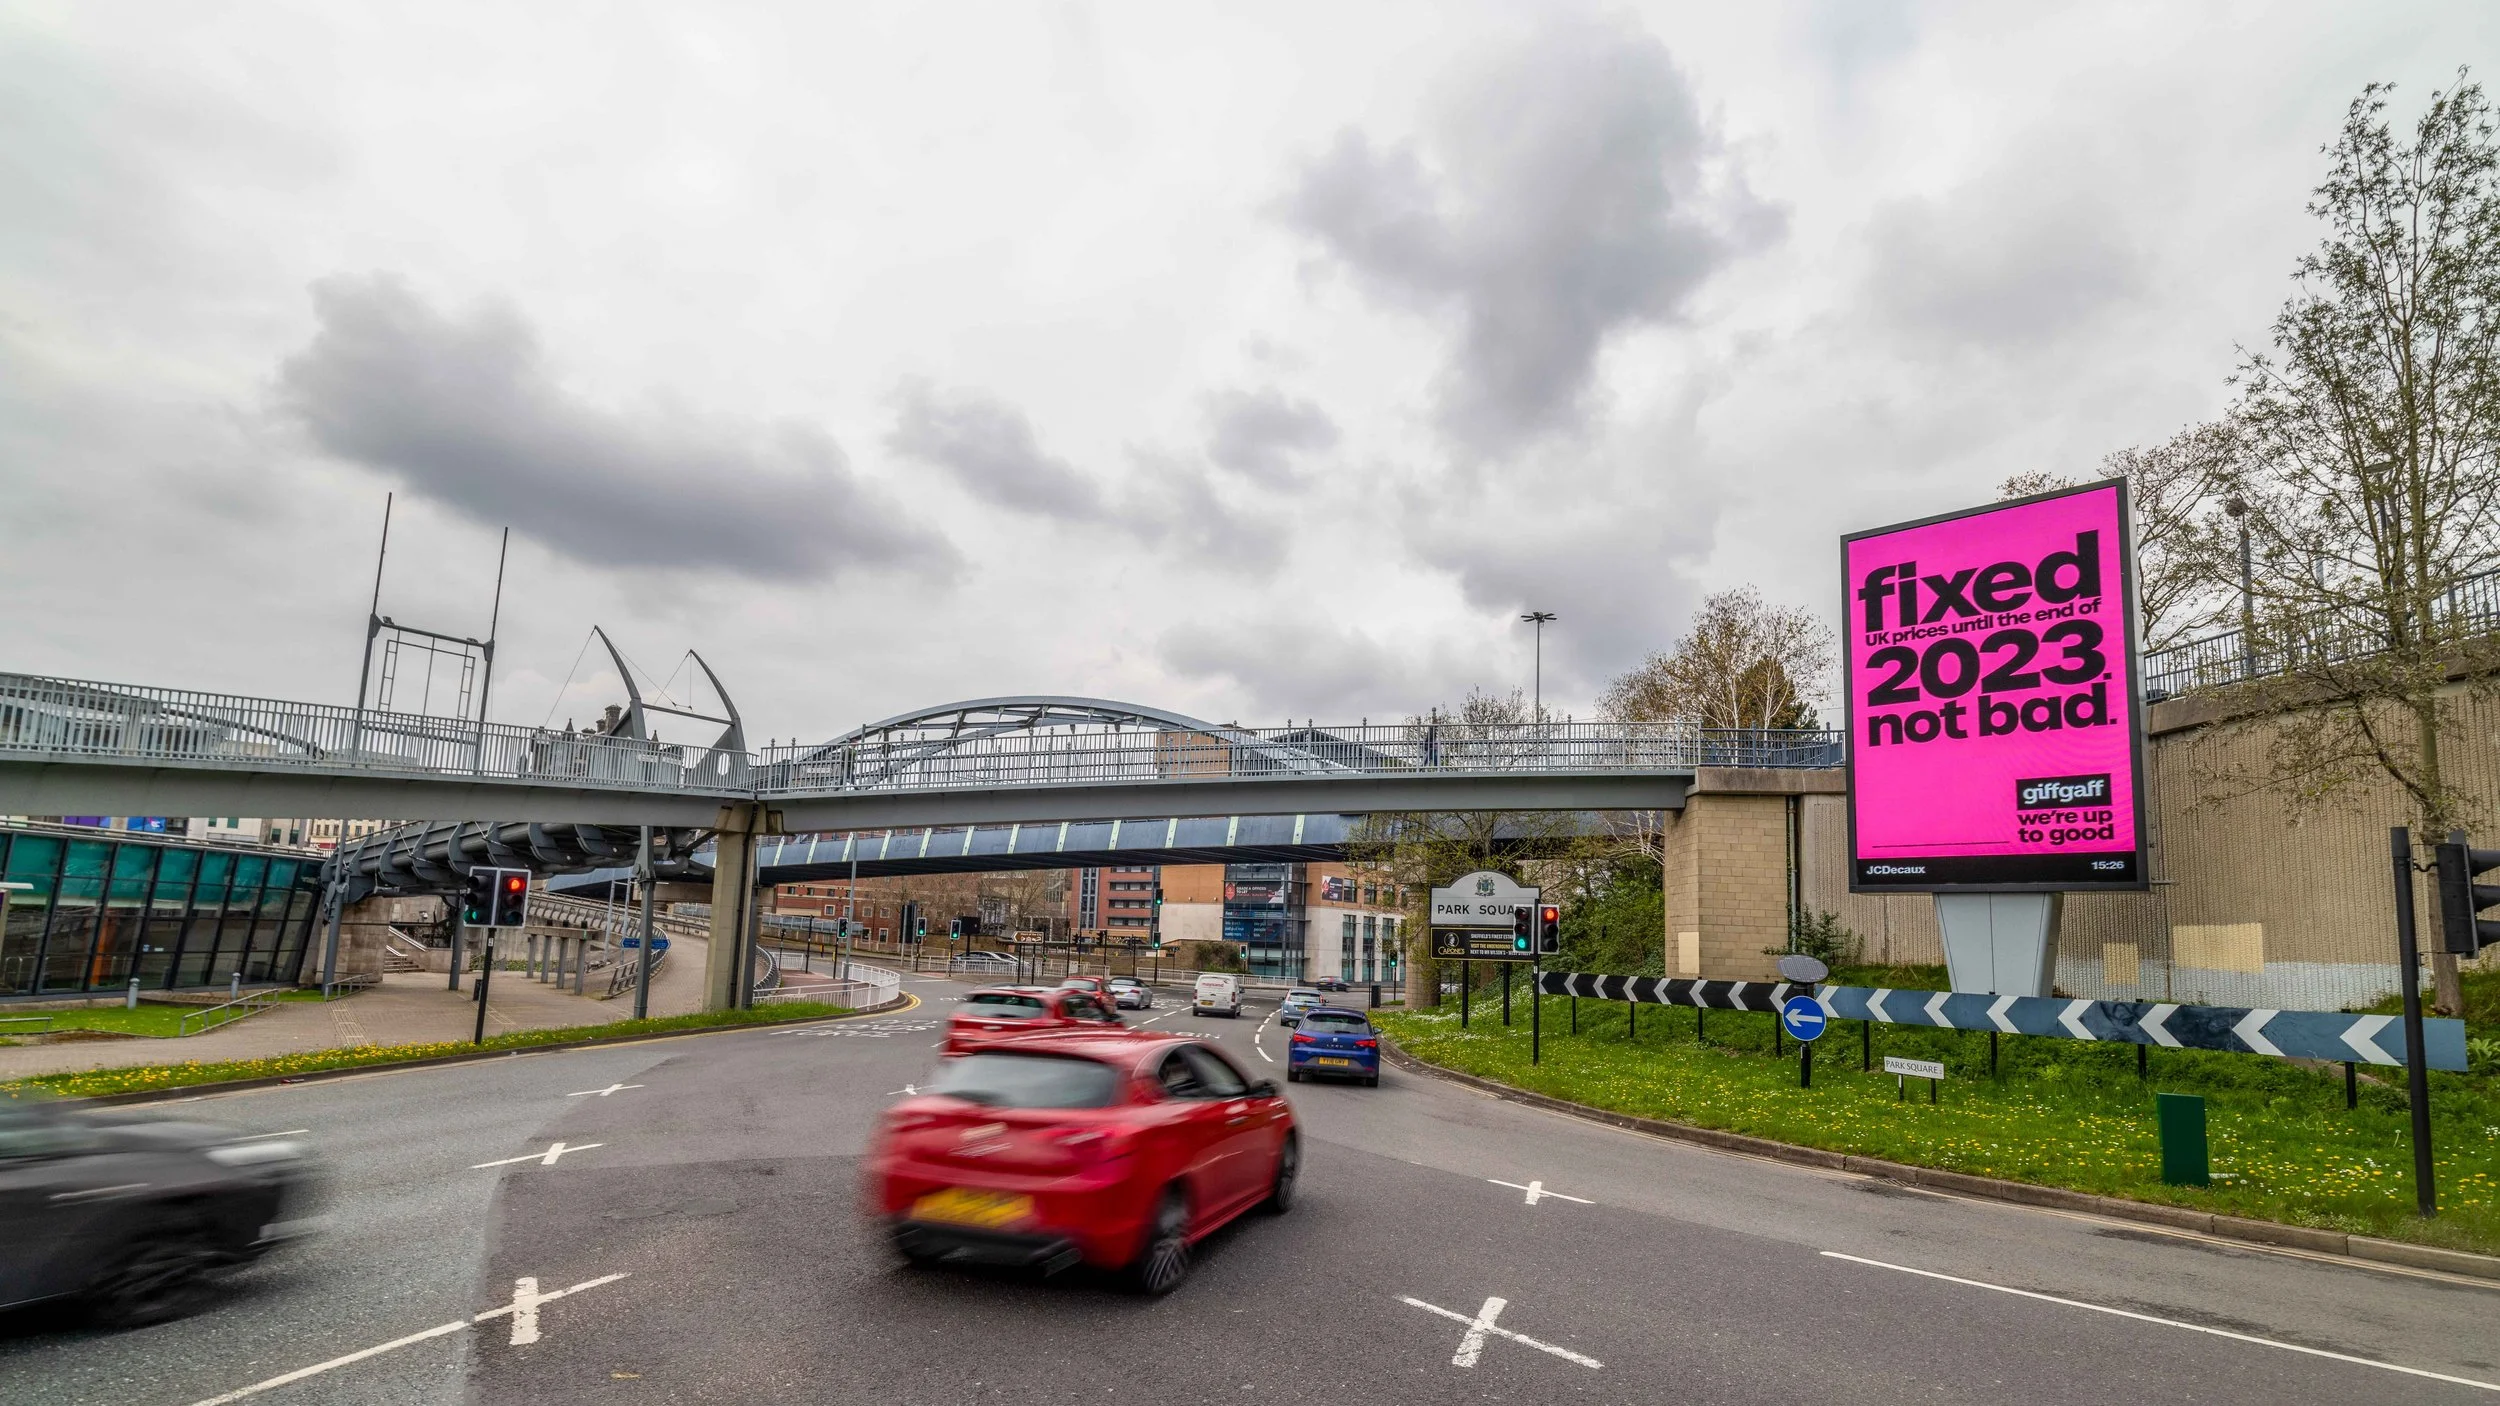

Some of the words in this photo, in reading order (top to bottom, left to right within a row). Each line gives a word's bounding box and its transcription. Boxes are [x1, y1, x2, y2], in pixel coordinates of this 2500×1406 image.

[1858, 530, 2101, 633] fixed
[1866, 632, 1889, 647] UK
[1892, 624, 1949, 646] prices
[1952, 614, 1993, 634] until
[1996, 611, 2031, 627] the
[2035, 600, 2074, 621] end
[2078, 598, 2103, 615] of
[1865, 619, 2112, 707] 2023.
[1868, 701, 1968, 747] not
[1977, 681, 2118, 737] bad.
[2022, 779, 2105, 805] giffgaff
[2017, 810, 2079, 826] we're
[2083, 810, 2114, 824] up
[2018, 827, 2044, 843] to
[2049, 823, 2115, 845] good
[1866, 864, 1926, 875] JCDecaux
[2091, 860, 2125, 871] 15:26
[1437, 904, 1470, 915] PARK
[1479, 904, 1514, 916] SQUA
[1886, 1060, 1906, 1070] PARK
[1906, 1063, 1938, 1073] SQUARE
